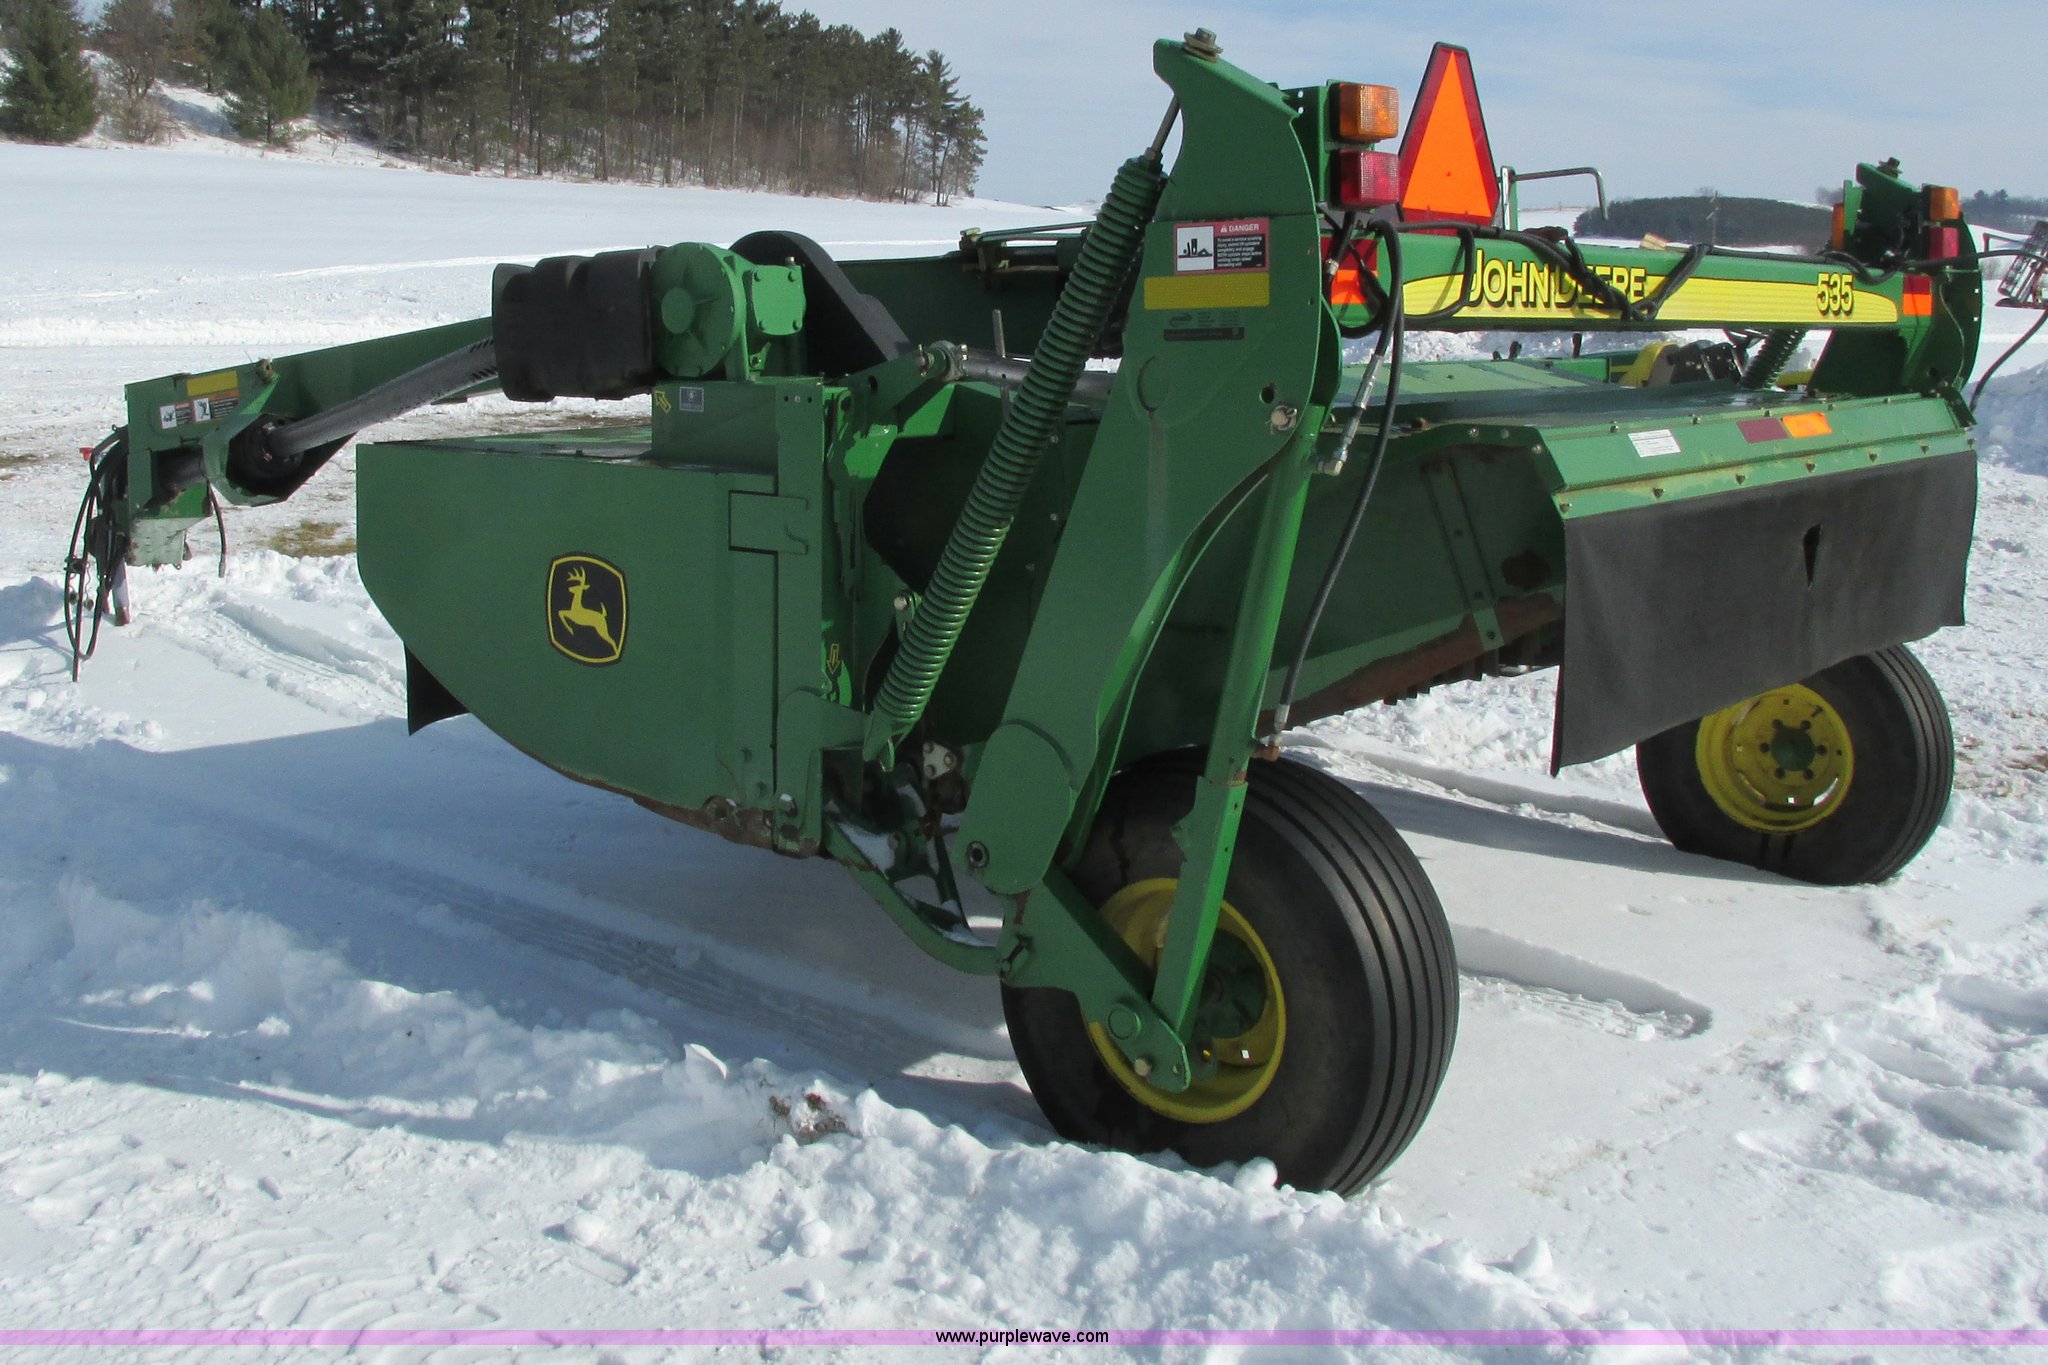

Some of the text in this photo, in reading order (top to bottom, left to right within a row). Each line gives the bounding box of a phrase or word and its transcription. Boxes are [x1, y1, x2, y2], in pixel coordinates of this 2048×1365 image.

[1228, 223, 1260, 232] DANGER
[1468, 248, 1647, 308] JOHN DRE
[1816, 271, 1855, 317] 535
